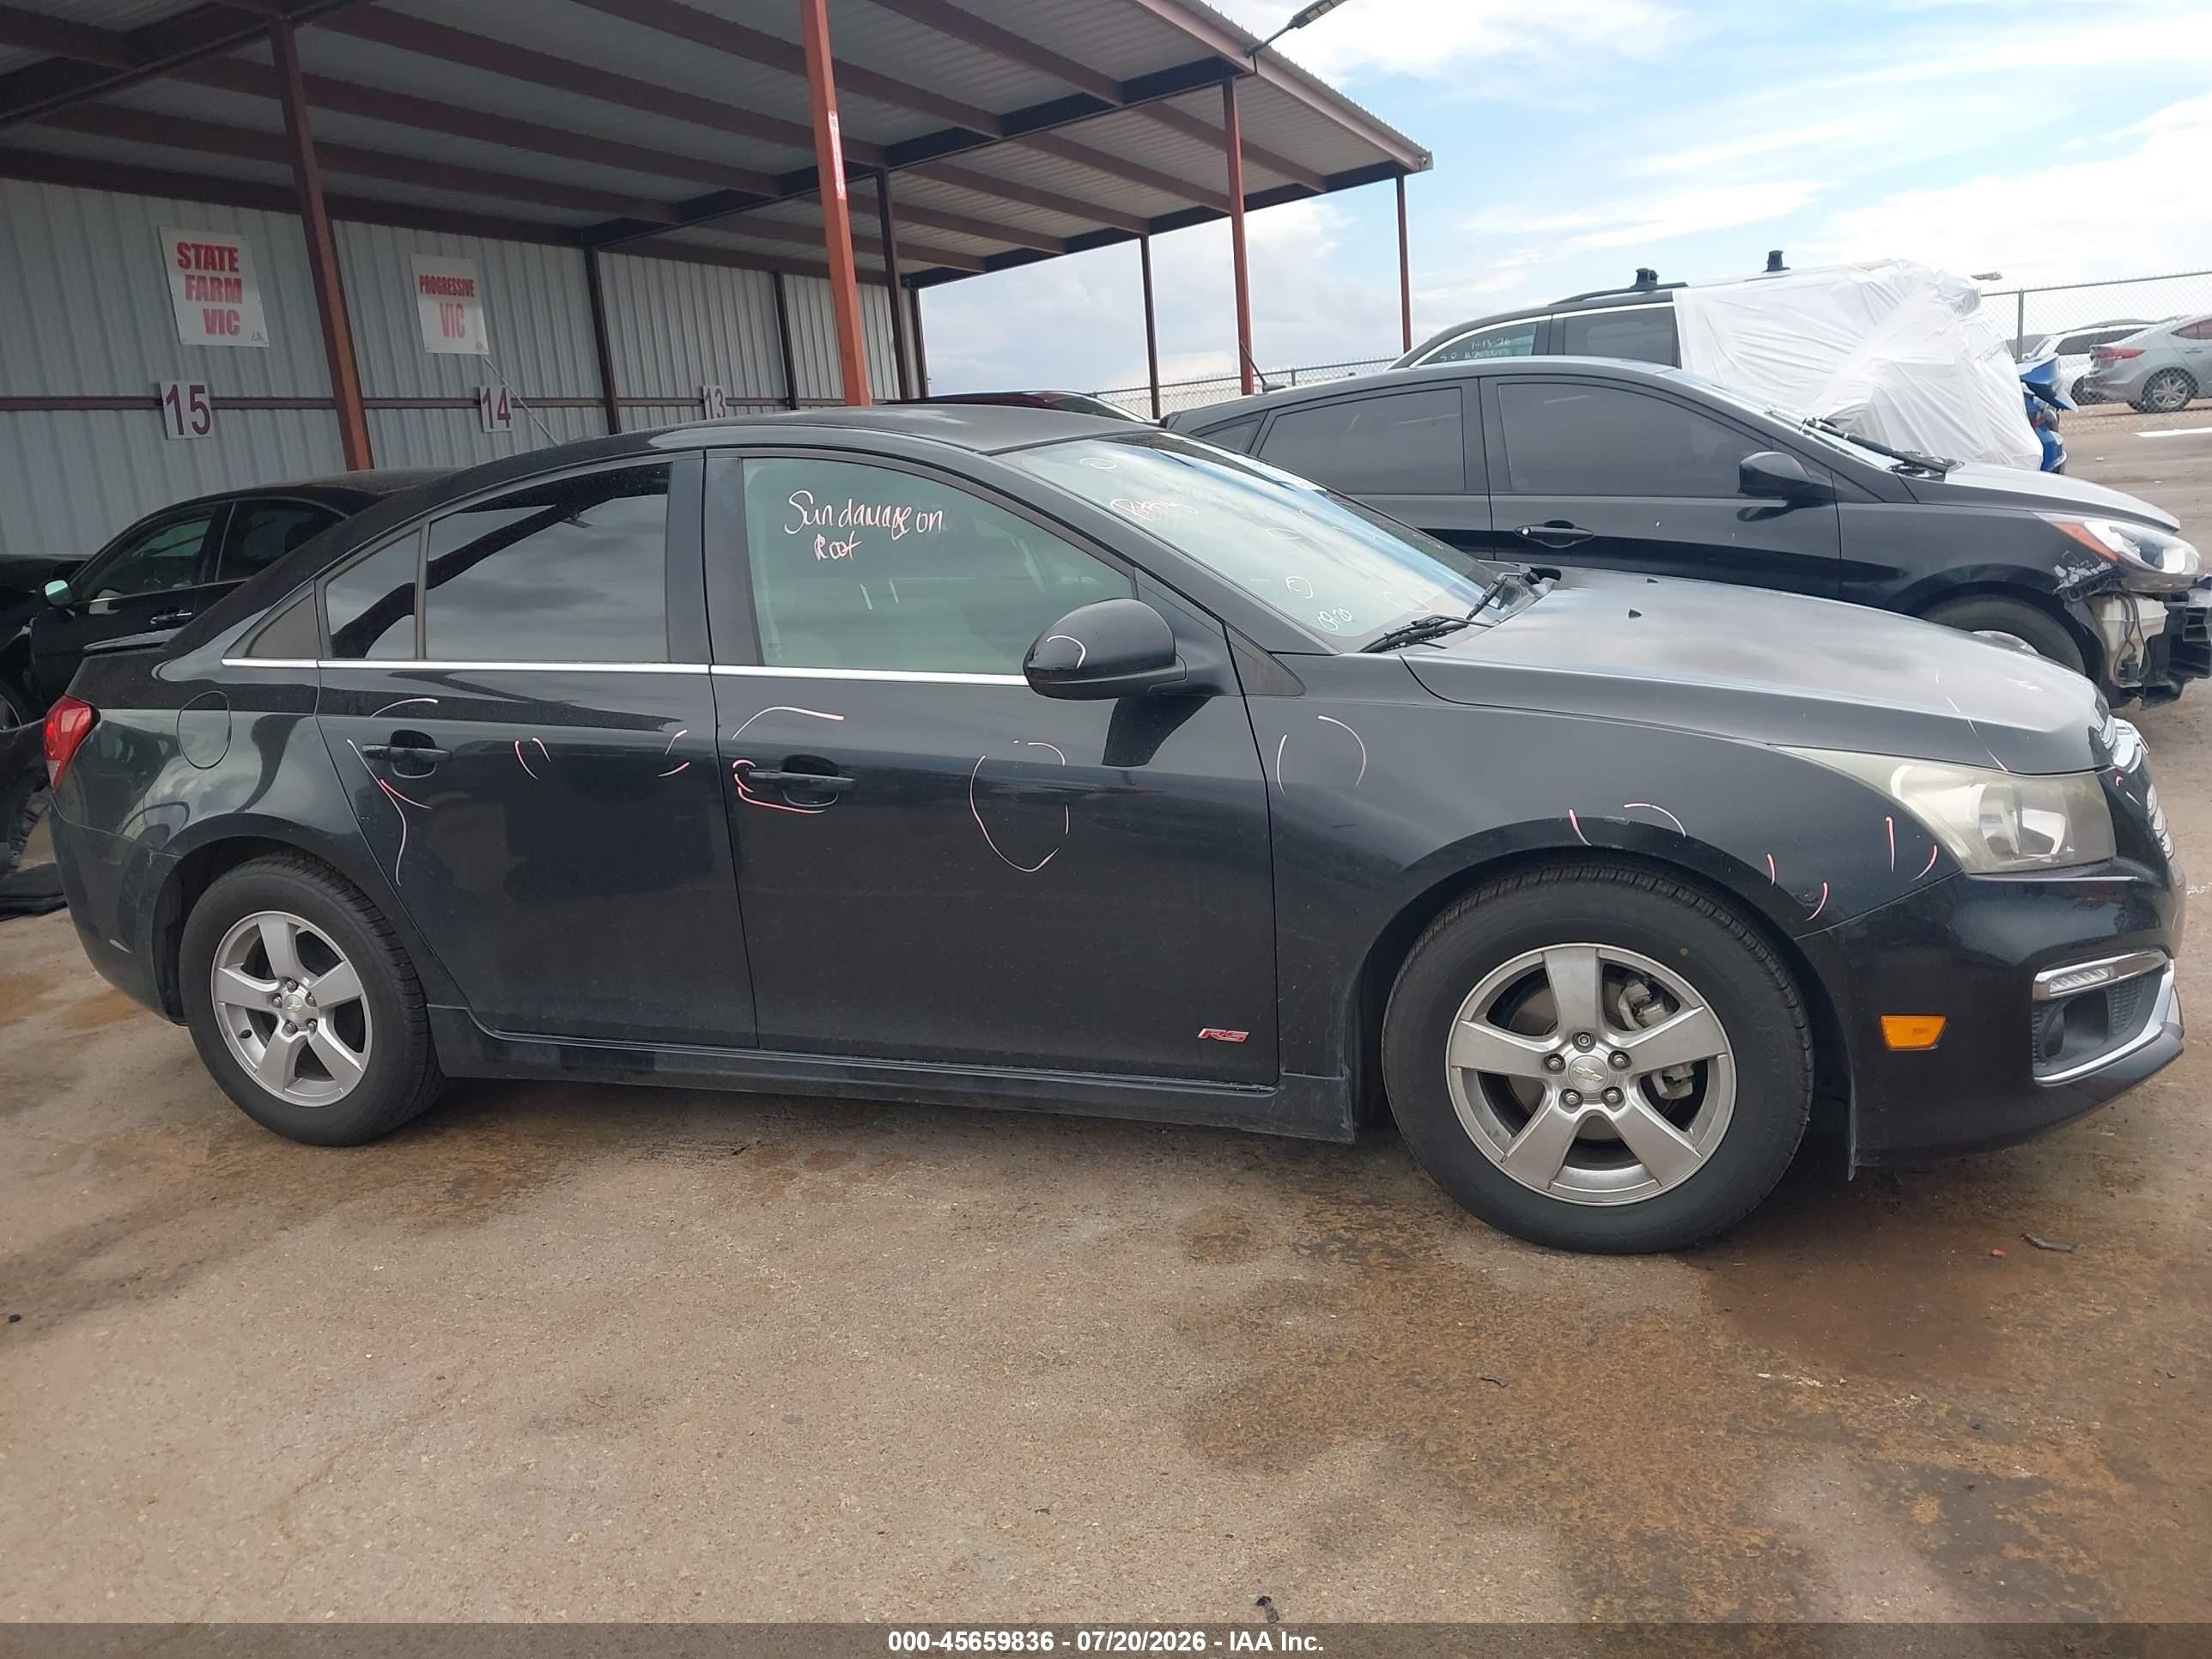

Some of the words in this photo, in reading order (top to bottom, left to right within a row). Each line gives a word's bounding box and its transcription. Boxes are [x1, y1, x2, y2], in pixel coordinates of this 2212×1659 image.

[177, 241, 240, 273] STATE
[185, 274, 243, 304] FARM
[418, 274, 474, 298] PROGRESSIVE
[203, 308, 241, 337] VIC
[439, 301, 465, 339] VIC
[166, 384, 211, 435] 15
[482, 386, 511, 429] 14
[705, 387, 726, 420] 13
[784, 489, 833, 534] Sun
[838, 498, 913, 540] damage
[915, 509, 944, 533] on
[1197, 1028, 1250, 1042] RS
